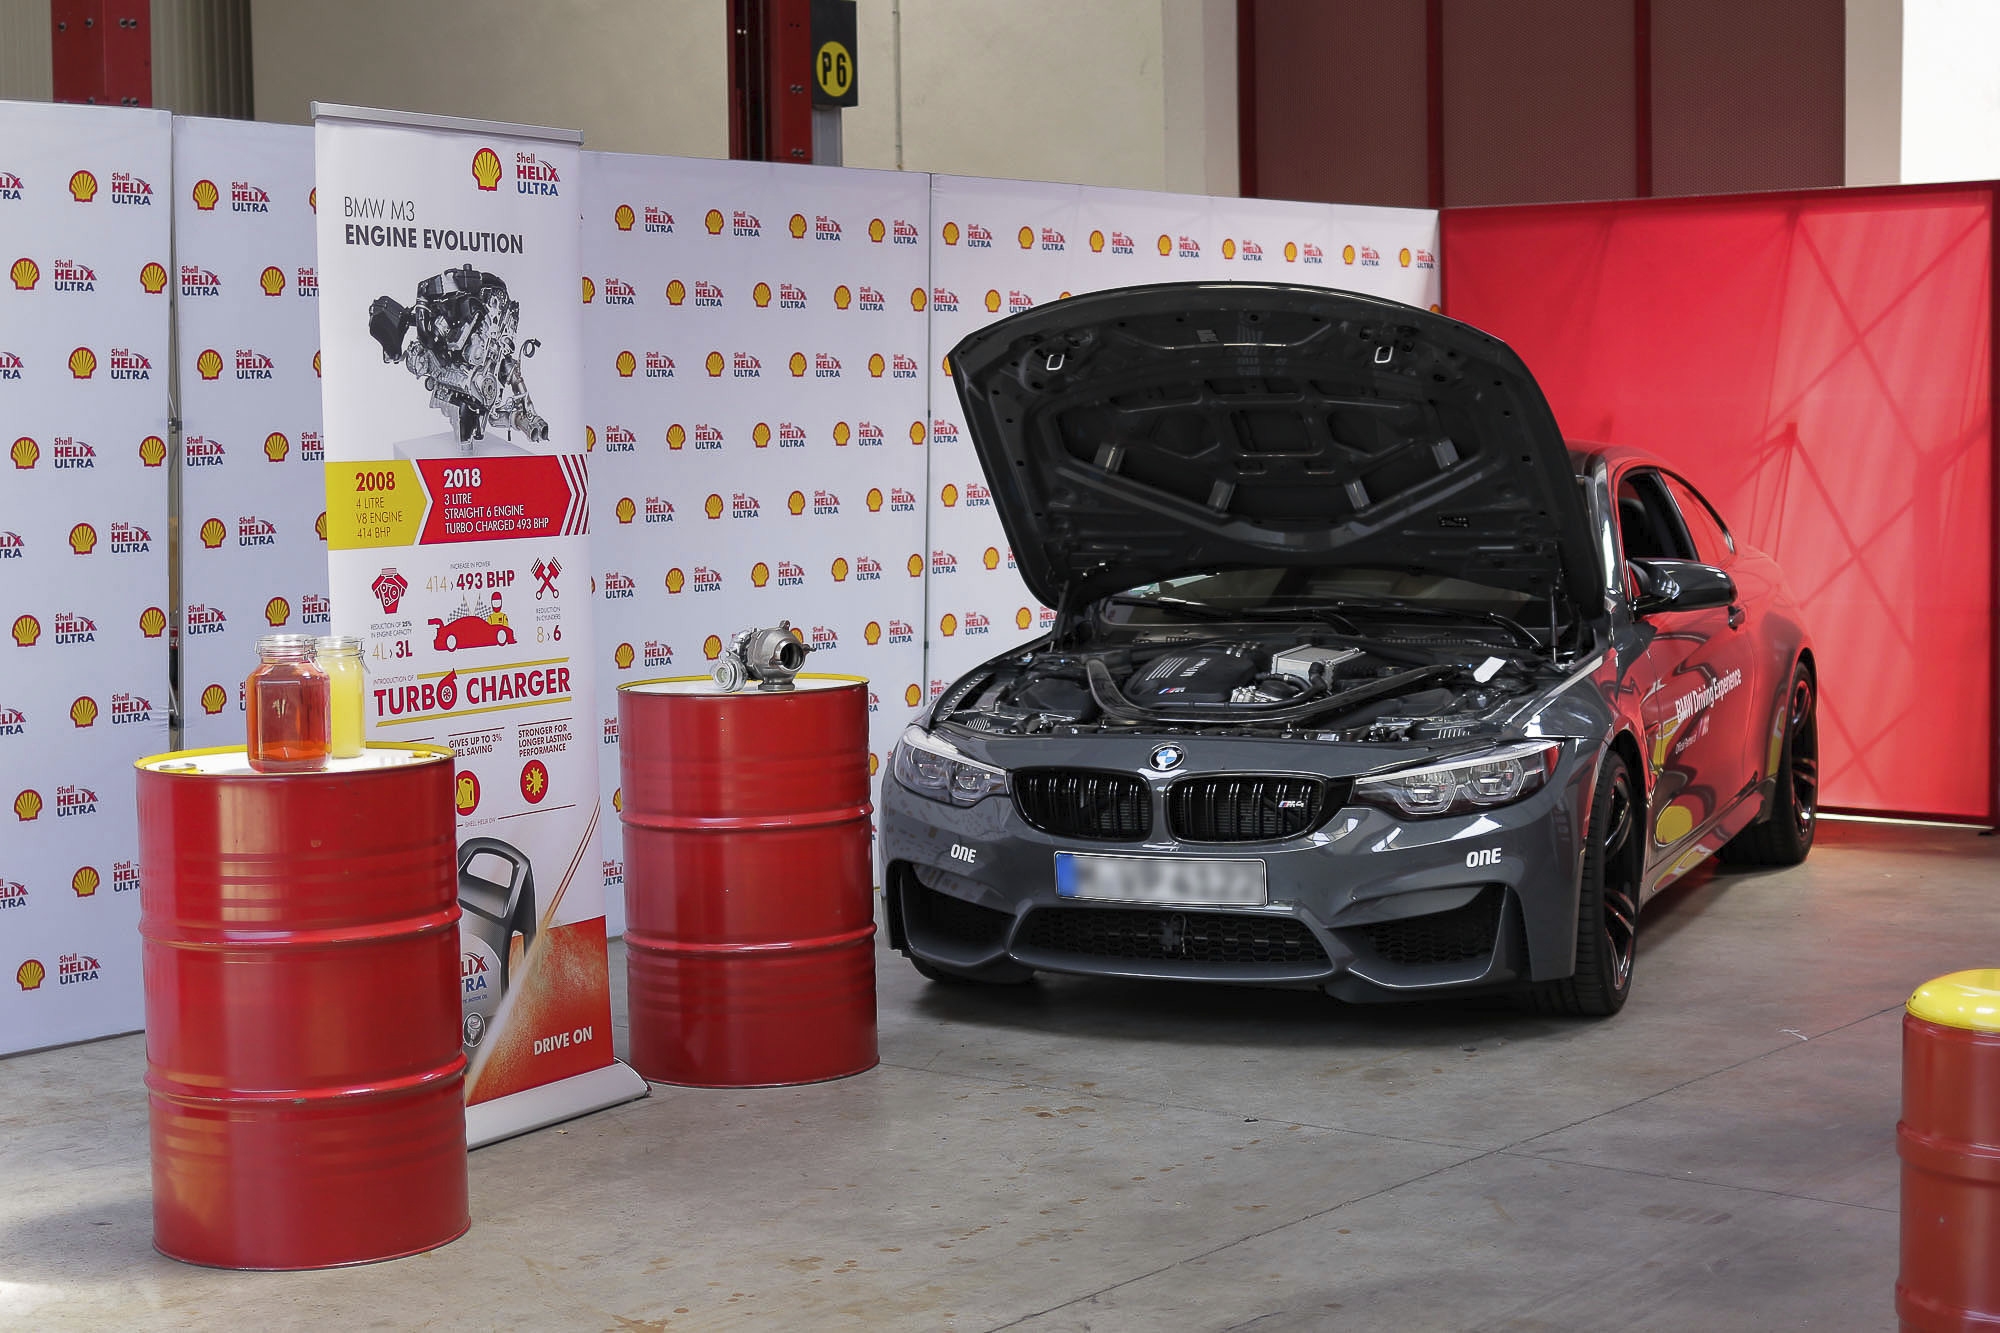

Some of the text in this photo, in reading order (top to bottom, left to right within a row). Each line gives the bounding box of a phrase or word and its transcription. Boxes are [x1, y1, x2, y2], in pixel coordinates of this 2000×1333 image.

[516, 152, 535, 164] Shell
[112, 173, 130, 181] Shell
[516, 165, 560, 182] HELIX
[112, 182, 152, 194] HELIX
[232, 182, 248, 190] Shell
[517, 181, 558, 196] ULTRA
[112, 194, 151, 205] ULTRA
[232, 191, 269, 202] HELIX
[232, 202, 268, 212] ULTRA
[344, 197, 415, 221] BMW M3
[645, 214, 673, 224] HELIX
[734, 219, 760, 228] HELIX
[645, 224, 673, 233] ULTRA
[734, 228, 760, 237] ULTRA
[345, 224, 523, 253] ENGINE EVOLUTION
[968, 231, 992, 240] HELIX
[1112, 238, 1134, 247] HELIX
[55, 260, 72, 268] Shell
[55, 269, 95, 280] HELIX
[182, 266, 198, 274] Shell
[55, 281, 94, 291] ULTRA
[182, 275, 220, 286] HELIX
[182, 286, 219, 296] ULTRA
[606, 286, 634, 295] HELIX
[781, 291, 805, 300] HELIX
[606, 296, 634, 304] ULTRA
[934, 292, 958, 303] HELIX
[934, 304, 957, 312] ULTRA
[111, 357, 150, 369] HELIX
[236, 358, 272, 369] HELIX
[646, 359, 674, 368] HELIX
[111, 370, 149, 379] ULTRA
[237, 370, 272, 379] ULTRA
[646, 369, 673, 377] ULTRA
[934, 426, 958, 435] HELIX
[55, 437, 72, 445] Shell
[187, 436, 203, 444] Shell
[607, 432, 635, 442] HELIX
[54, 446, 95, 457] HELIX
[187, 445, 224, 456] HELIX
[607, 444, 634, 452] ULTRA
[55, 459, 94, 468] ULTRA
[187, 456, 223, 466] ULTRA
[356, 471, 396, 491] 2008
[443, 468, 481, 488] 2018
[444, 493, 472, 505] 3 LITRE
[967, 490, 989, 498] HELIX
[356, 497, 385, 509] 4 LITRE
[646, 504, 674, 513] HELIX
[356, 511, 403, 524] V8 ENGINE
[444, 505, 524, 519] STRAIGHT 6 ENGINE
[646, 514, 673, 523] ULTRA
[112, 522, 128, 530] Shell
[445, 517, 549, 534] TURBO CHARGED 493 BHP
[111, 530, 150, 542] HELIX
[357, 527, 391, 538] 414 BHP
[111, 543, 149, 553] ULTRA
[778, 568, 804, 577] HELIX
[426, 570, 515, 592] 414 493 BHP
[606, 579, 634, 589] HELIX
[778, 578, 803, 586] ULTRA
[606, 589, 633, 599] ULTRA
[188, 604, 204, 612] Shell
[56, 613, 73, 621] Shell
[188, 611, 225, 624] HELIX
[55, 620, 96, 633] HELIX
[188, 623, 224, 635] ULTRA
[56, 632, 94, 644] ULTRA
[537, 625, 561, 643] 8 6
[372, 640, 413, 660] 4L 3L
[373, 667, 571, 716] TURBO CHARGER
[1675, 668, 1742, 723] BMW Driving Experience
[518, 724, 567, 738] STRONGER FOR
[448, 733, 502, 748] GIVES UP TO 3%
[518, 733, 572, 748] LONGER LASTING
[466, 745, 493, 756] SAVING
[519, 743, 566, 757] PERFORMANCE
[57, 784, 75, 794] Shell
[57, 793, 97, 805] HELIX
[57, 804, 96, 817] ULTRA
[951, 844, 976, 863] ONE
[1466, 848, 1501, 867] ONE
[60, 953, 77, 963] Shell
[60, 960, 99, 973] HELIX
[461, 955, 488, 977] LIX
[60, 971, 98, 984] ULTRA
[534, 1026, 593, 1055] DRIVE ON
